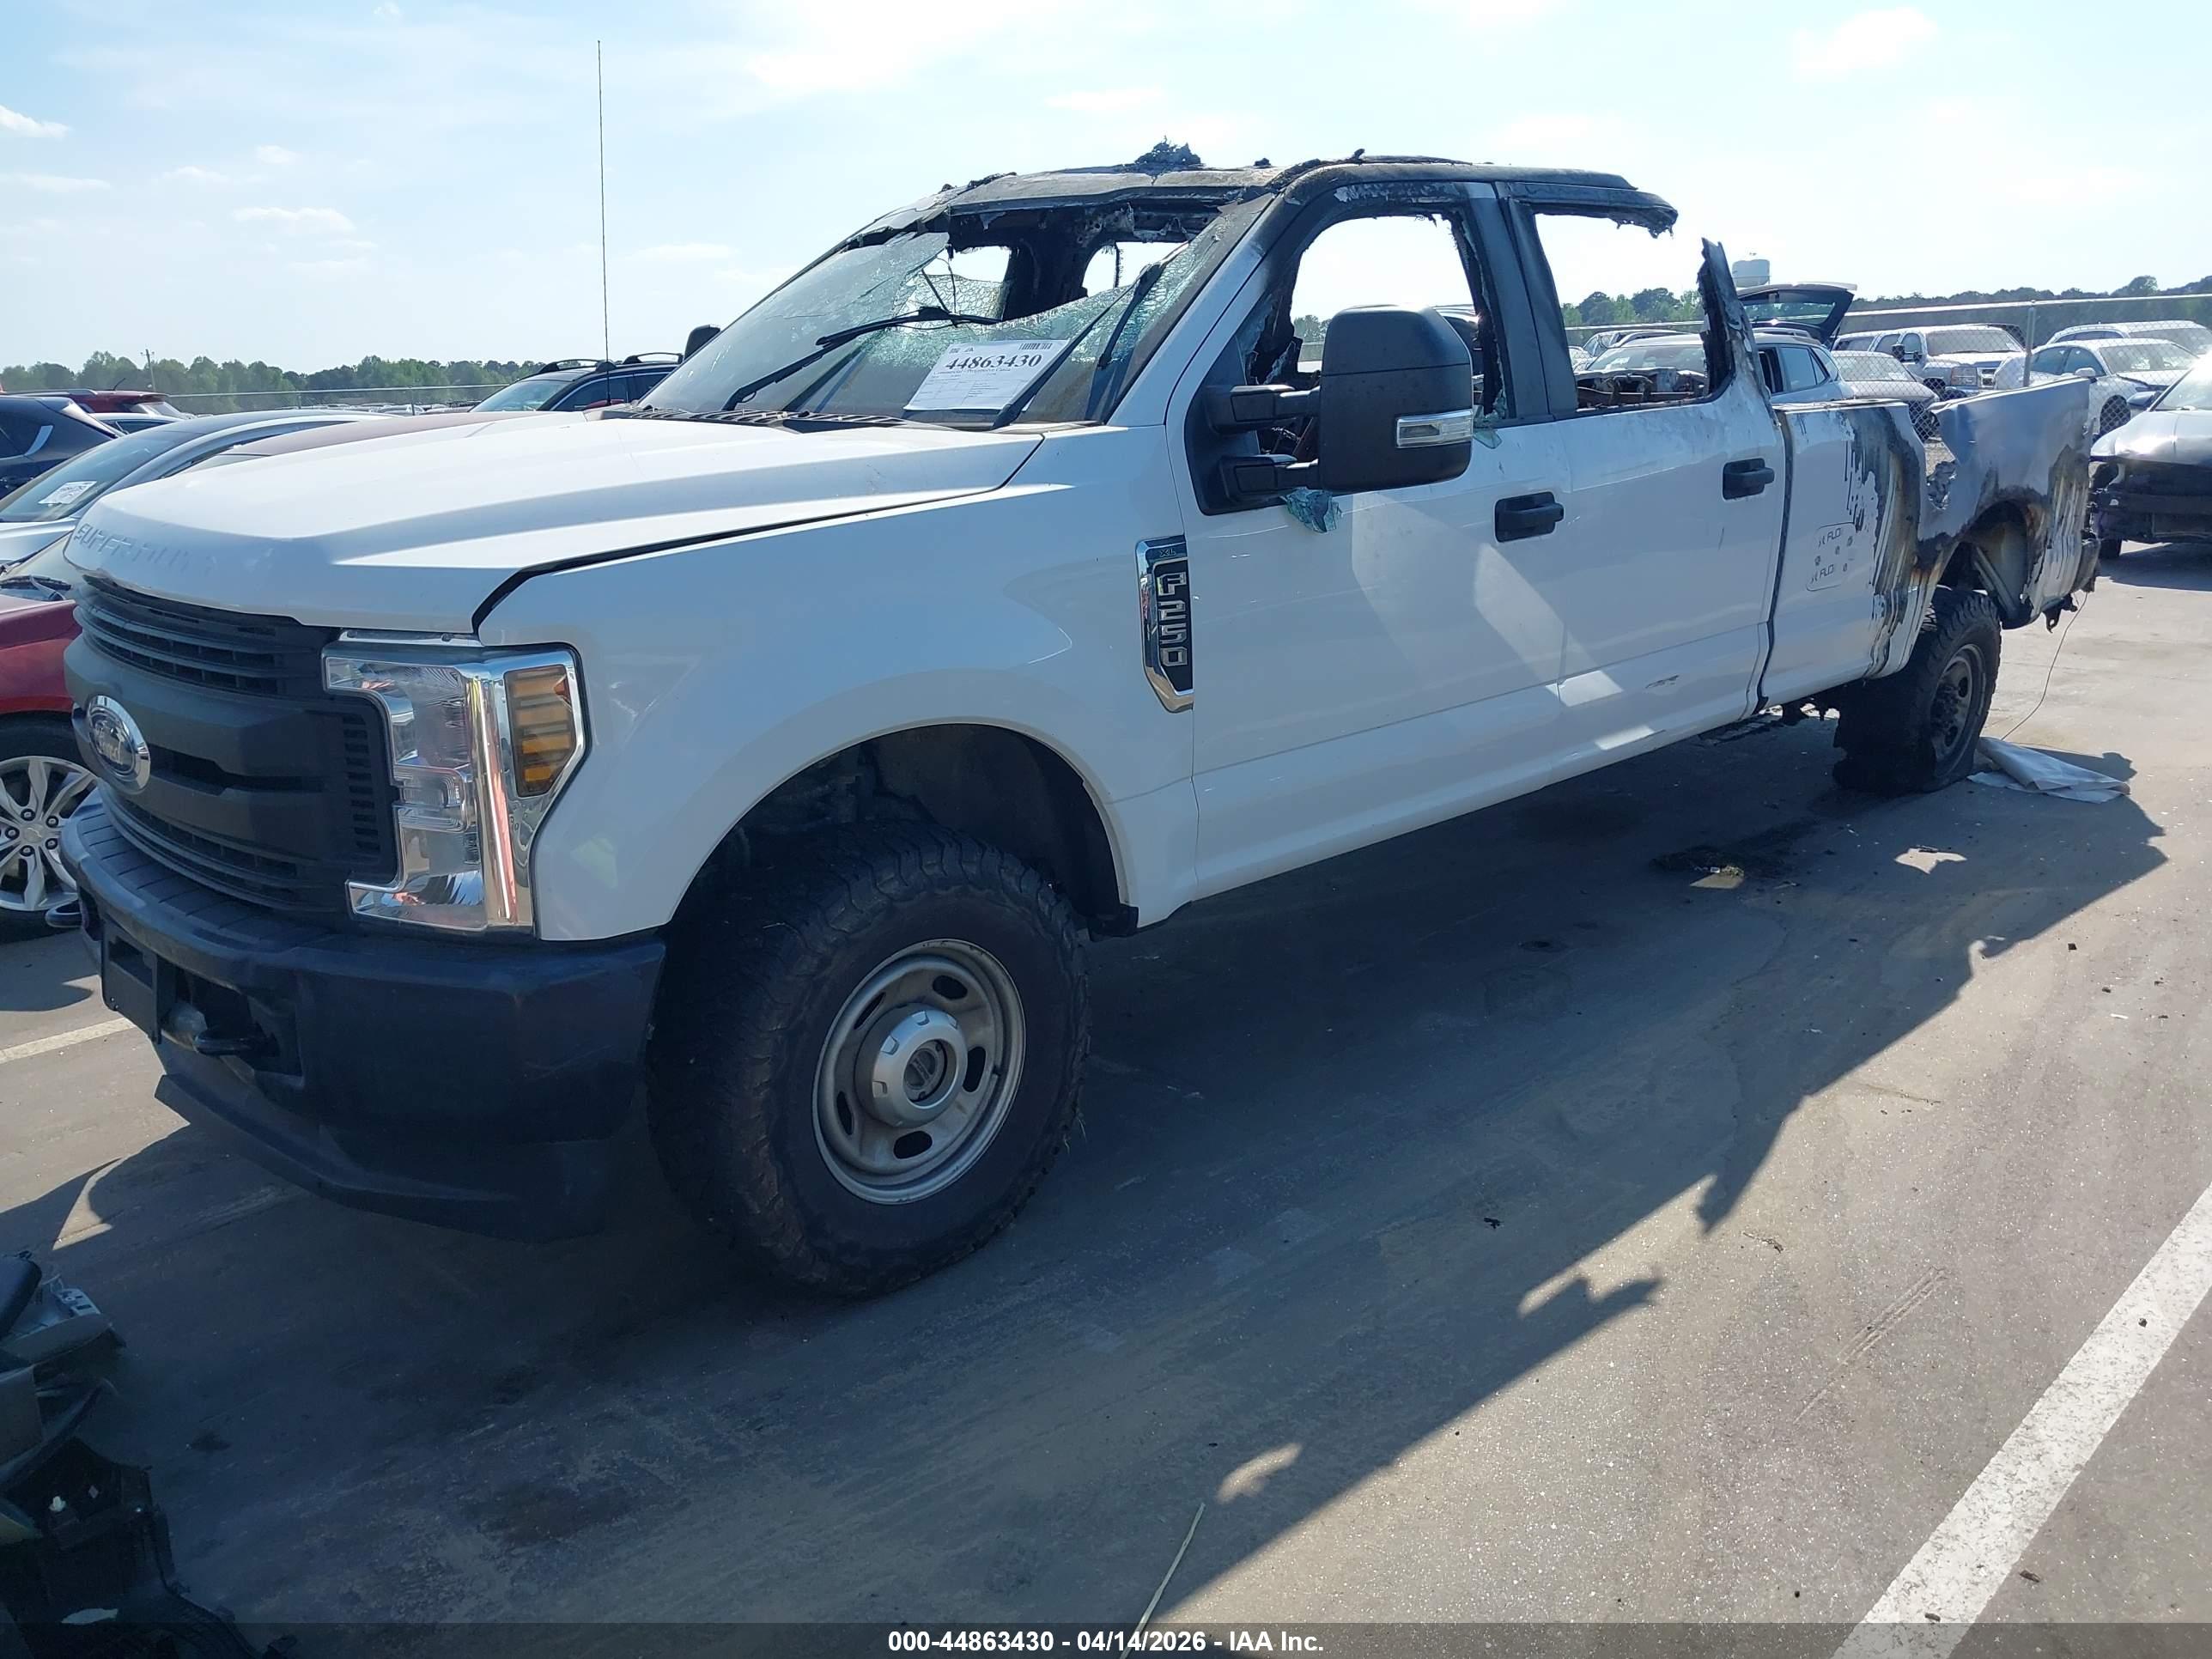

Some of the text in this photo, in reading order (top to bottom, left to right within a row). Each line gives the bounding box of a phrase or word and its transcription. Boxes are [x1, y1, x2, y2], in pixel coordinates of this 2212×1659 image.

[945, 354, 1042, 370] 44863430
[1160, 547, 1176, 556] XL
[1158, 571, 1188, 667] F250
